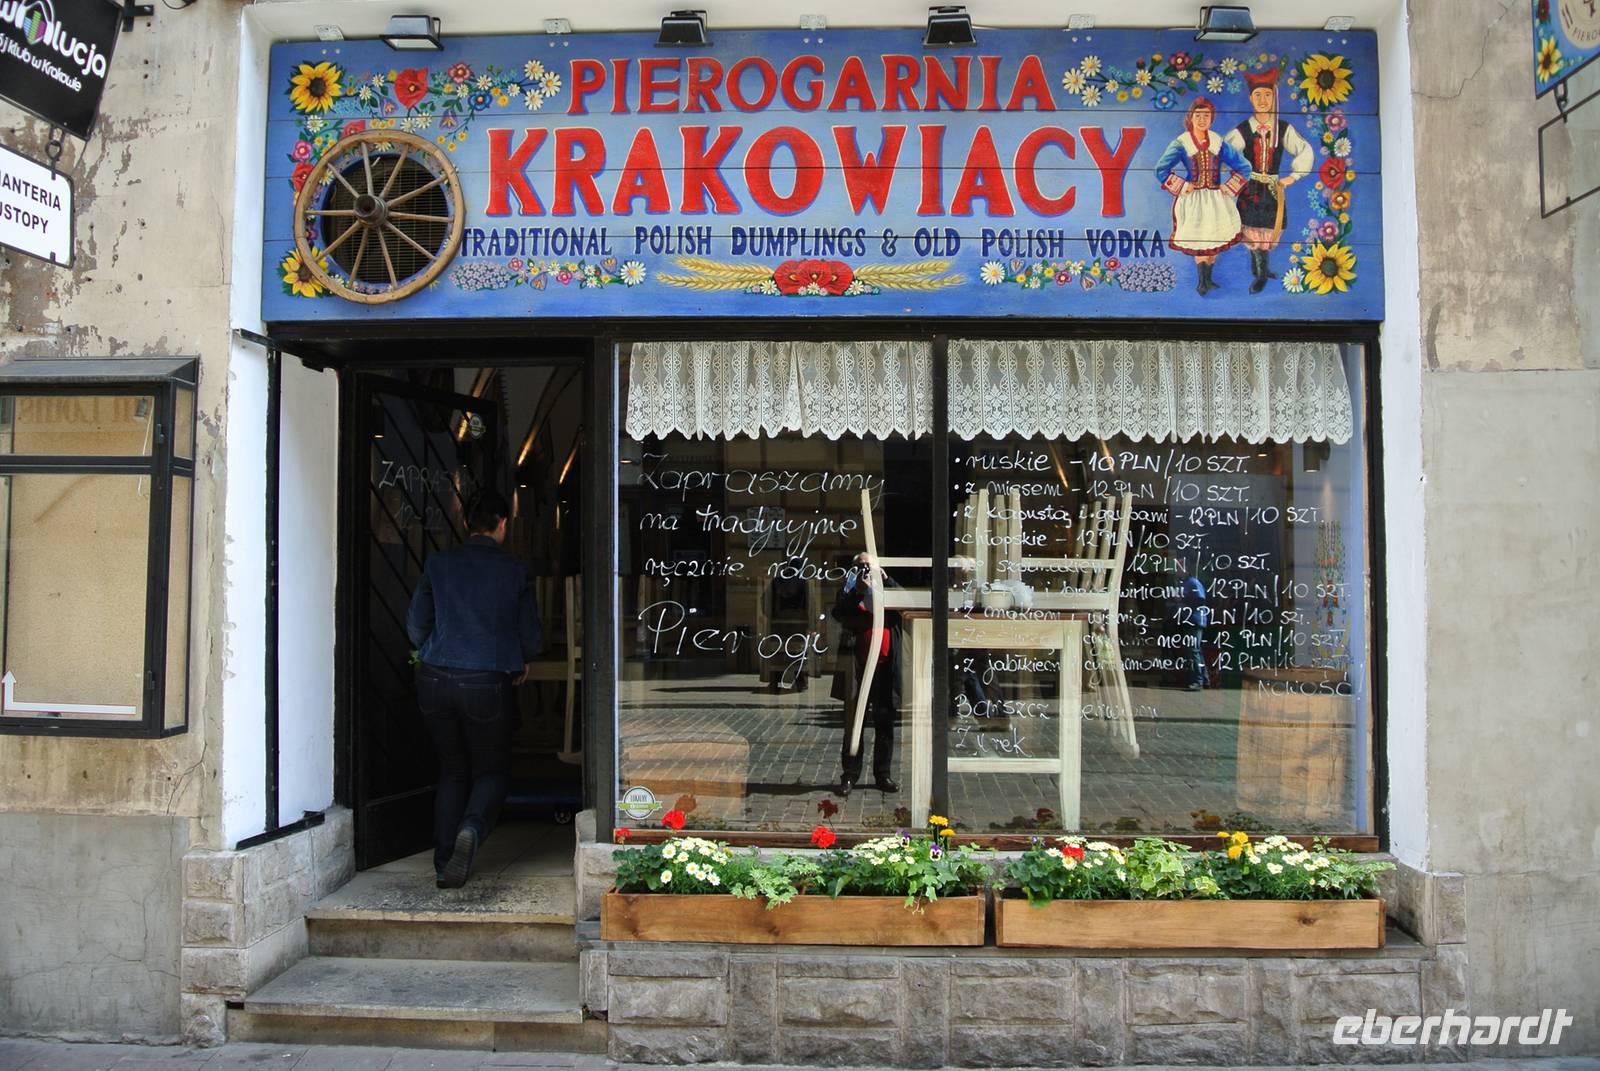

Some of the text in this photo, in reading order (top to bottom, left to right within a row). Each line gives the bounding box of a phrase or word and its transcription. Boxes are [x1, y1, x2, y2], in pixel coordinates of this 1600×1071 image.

[8, 36, 31, 62] klub
[41, 58, 82, 92] Krakowie
[566, 54, 1057, 115] PIEROGARNIA
[0, 170, 61, 211] ANTERIA
[485, 124, 1147, 218] KRAKOWIACY
[461, 225, 1166, 259] TRADITIONAL POLISH DUMPLINGS & OLD POLISH VODKA
[965, 450, 1053, 472] ruskie
[640, 512, 690, 532] na
[768, 556, 872, 581] robion
[638, 600, 829, 690] Pierogi
